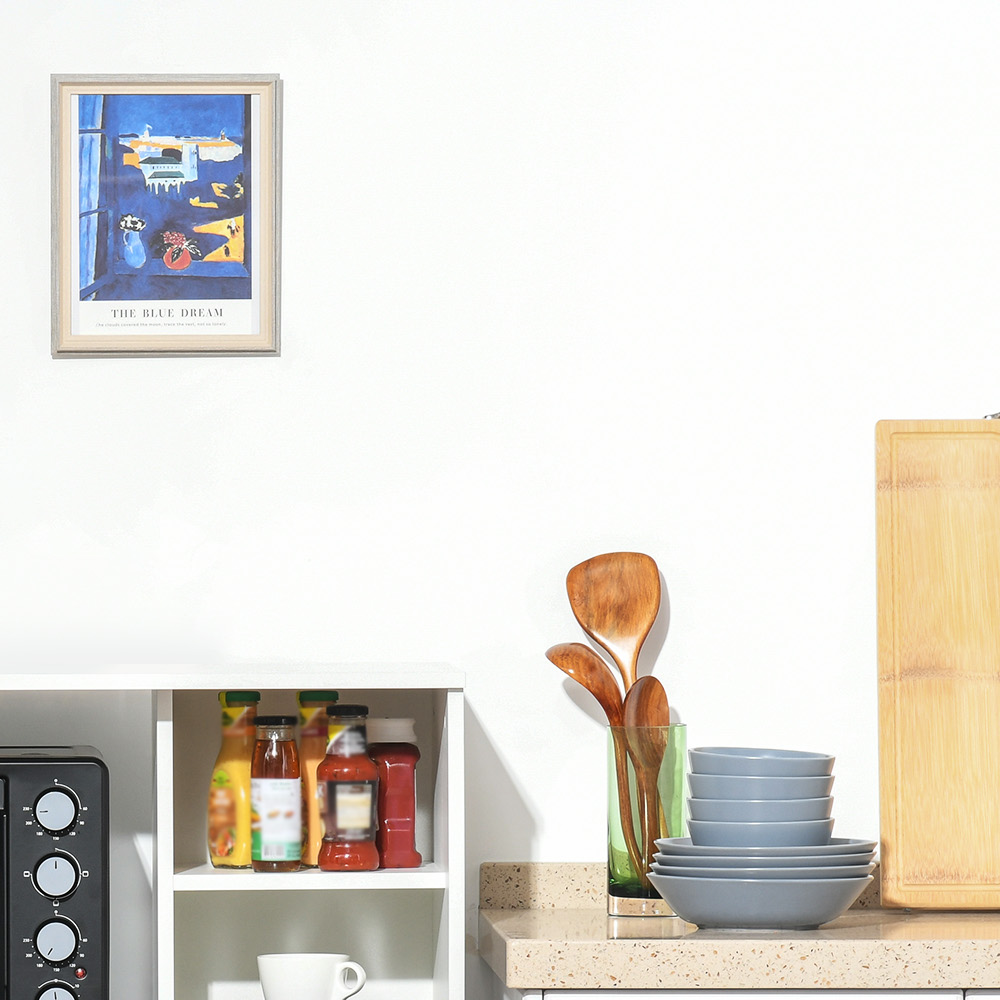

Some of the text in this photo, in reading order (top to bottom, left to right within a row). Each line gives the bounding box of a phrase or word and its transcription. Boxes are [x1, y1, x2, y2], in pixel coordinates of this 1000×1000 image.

[110, 308, 223, 318] THE BLUE DREAM
